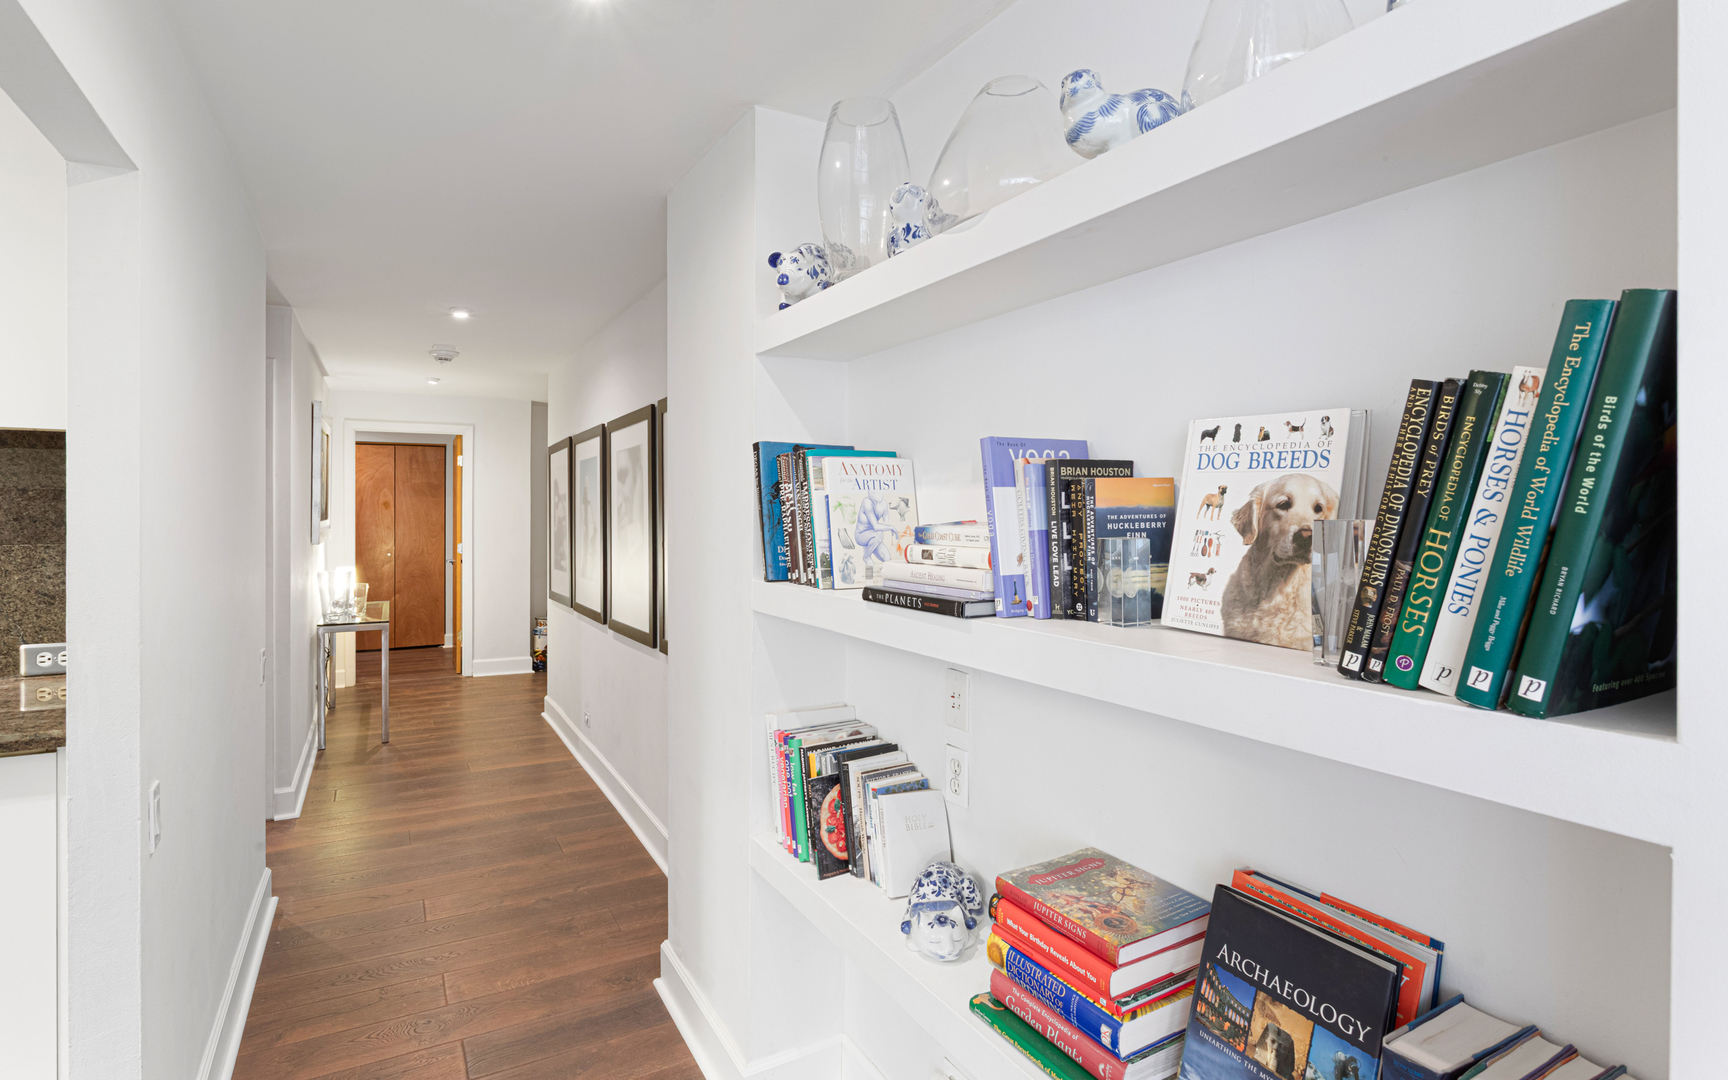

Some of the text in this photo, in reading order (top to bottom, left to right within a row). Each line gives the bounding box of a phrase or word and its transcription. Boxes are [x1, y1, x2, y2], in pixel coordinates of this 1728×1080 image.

[1196, 449, 1331, 470] DOG BREEDS
[1223, 441, 1311, 452] ENCYCLOPEDIA
[1317, 440, 1333, 448] OF
[1417, 395, 1455, 498] BIRDS of PREY
[1482, 408, 1530, 503] HORSES
[1505, 321, 1591, 577] The Encyclopedia of World Wildlife
[1574, 395, 1618, 514] Birds of the World
[838, 461, 904, 476] ANATOMY
[852, 477, 898, 491] ARTIST
[1060, 466, 1131, 476] BRIAN HOUSTON
[1361, 386, 1417, 583] AND OTHER PREHISTORIC CREATURES
[1369, 387, 1432, 587] ENCYCLOPEDIA OF DINOSAURS
[1438, 415, 1476, 521] ENCYCLOPEDIA OF
[987, 510, 995, 537] yoga
[1107, 522, 1167, 530] HUCKLEBERRY
[1473, 508, 1498, 526] &
[910, 570, 927, 580] ANCIENT
[927, 571, 945, 582] HEALING
[1402, 527, 1452, 637] HORSES
[1447, 533, 1492, 617] PONIES
[1549, 566, 1568, 615] BRYAN RICHARD
[884, 593, 922, 609] PLANETS
[1180, 605, 1203, 613] NEARLY
[1184, 612, 1207, 620] BREEDS
[1190, 597, 1220, 606] PICTURES
[1380, 568, 1406, 637] PAUL D. FROST
[1493, 609, 1502, 620] and
[1365, 612, 1376, 629] JOHN
[1592, 680, 1620, 693] Featuring
[1621, 678, 1633, 686] over
[1645, 671, 1666, 682] Species
[780, 757, 788, 808] vegetarian
[904, 813, 927, 824] HOLY
[905, 822, 927, 832] BIBLE
[1035, 860, 1103, 885] JUPITER SIGNS
[1033, 901, 1063, 925] JUPITER
[1063, 919, 1087, 939] SIGNS
[1006, 917, 1018, 931] What
[1018, 925, 1029, 938] Your
[1029, 933, 1049, 953] Birthday
[1050, 946, 1069, 965] Reveals
[1069, 960, 1086, 975] About
[1086, 970, 1097, 984] You
[1007, 950, 1066, 998] ILLUSTRATED
[1007, 961, 1064, 1009] DICTIONARY OF
[1216, 943, 1372, 1043] ARCHAEOLOGY
[1005, 995, 1043, 1034] Garden
[1046, 1025, 1083, 1064] Plants
[1012, 987, 1020, 997] The
[1020, 994, 1041, 1013] Complete
[1041, 1010, 1072, 1037] Encyclopedia
[1199, 1030, 1258, 1074] UNEARTHING THE
